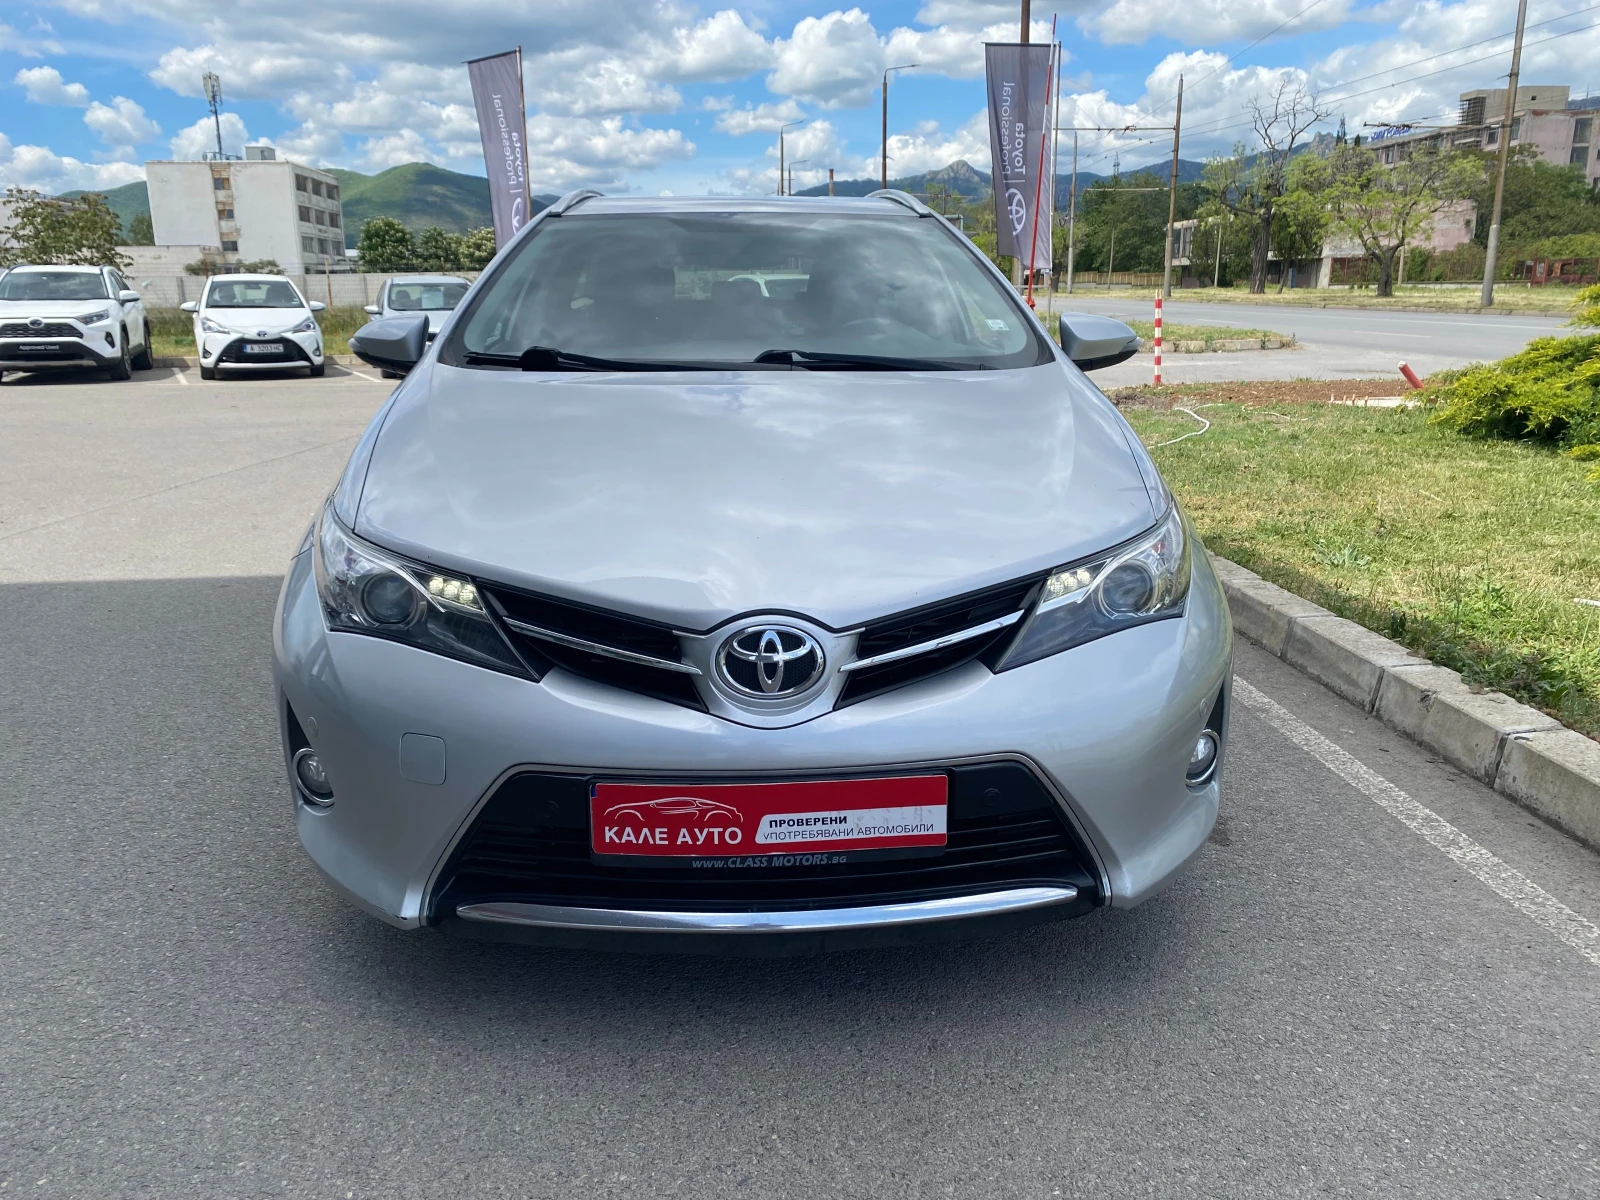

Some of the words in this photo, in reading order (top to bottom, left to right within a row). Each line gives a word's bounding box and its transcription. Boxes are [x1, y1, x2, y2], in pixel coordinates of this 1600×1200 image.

[769, 816, 848, 829] ПРОВЕРЕНИ
[604, 826, 669, 845] КАЛЕ
[676, 827, 743, 845] АУТО
[763, 827, 854, 842] УПОТРЕБЯВАНИ
[856, 823, 934, 836] АВТОМОБИЛИ
